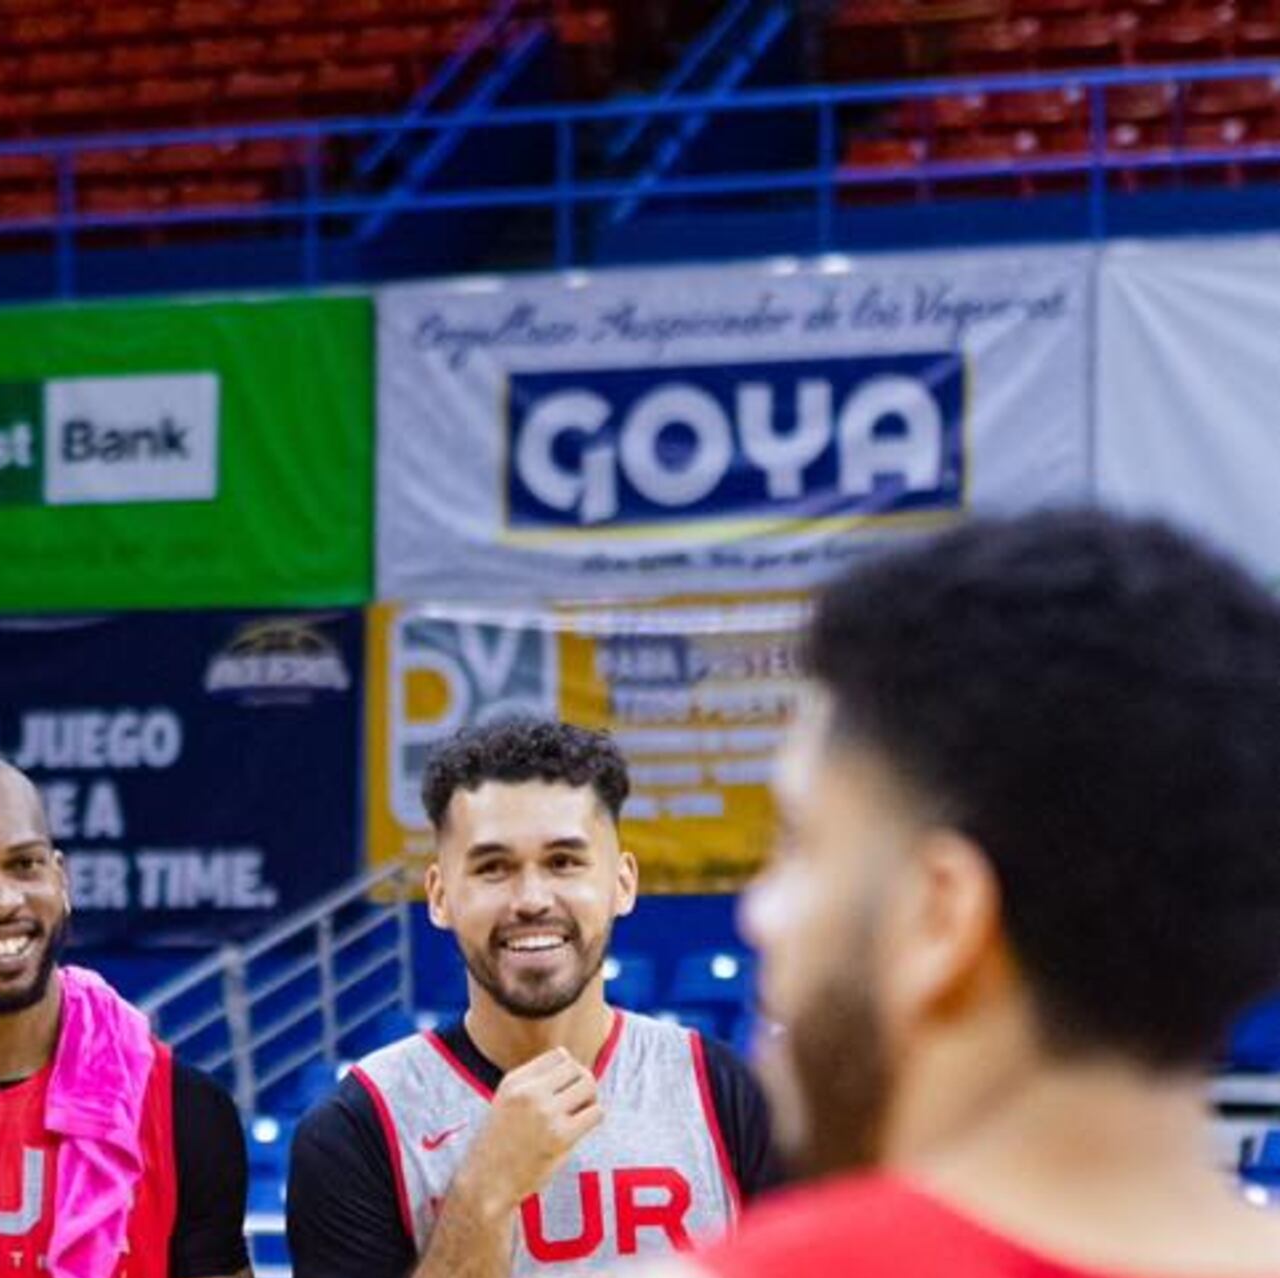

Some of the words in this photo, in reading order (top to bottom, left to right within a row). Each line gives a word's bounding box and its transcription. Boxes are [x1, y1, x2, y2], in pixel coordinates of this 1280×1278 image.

[61, 416, 190, 465] Bank
[517, 374, 942, 525] GOYA
[17, 706, 182, 769] JUEGO
[82, 779, 125, 840] A
[136, 849, 278, 910] TIME.
[520, 1166, 695, 1264] UR
